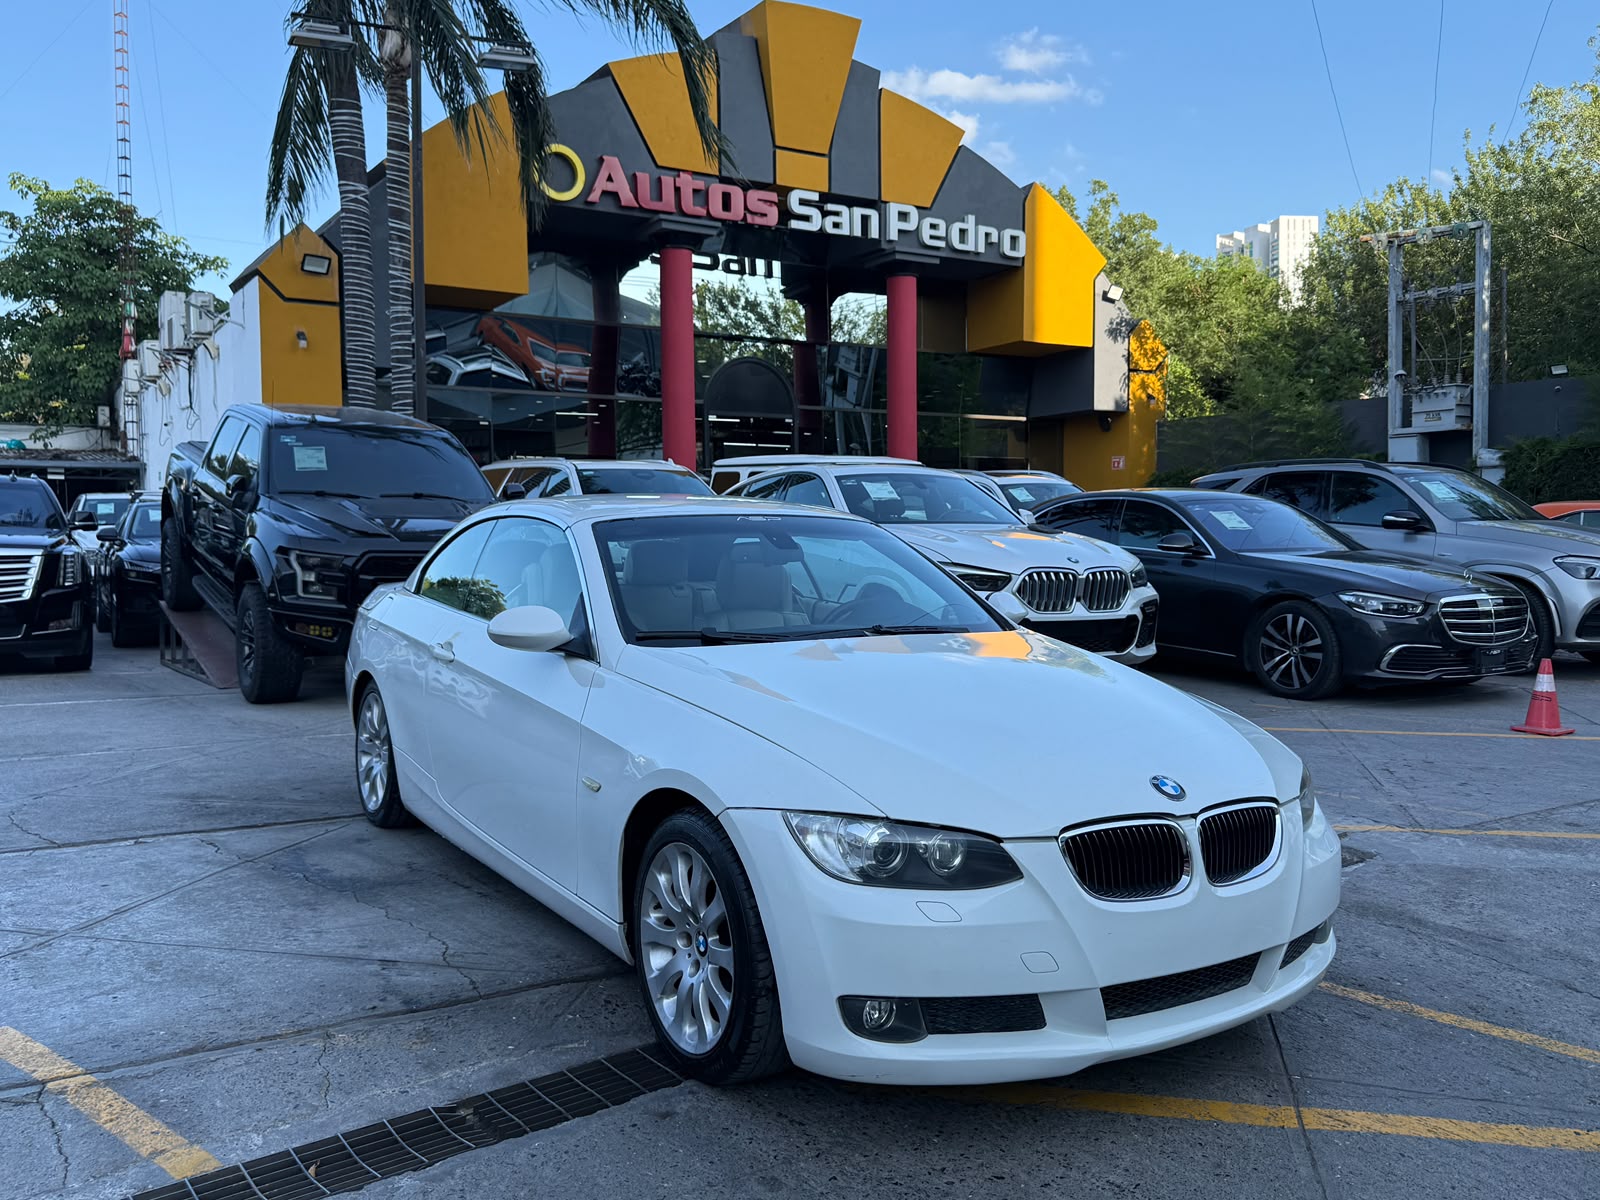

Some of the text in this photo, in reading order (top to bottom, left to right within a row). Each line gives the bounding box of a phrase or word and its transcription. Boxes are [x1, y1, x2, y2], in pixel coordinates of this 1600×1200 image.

[586, 155, 1026, 258] Autos San Pedro
